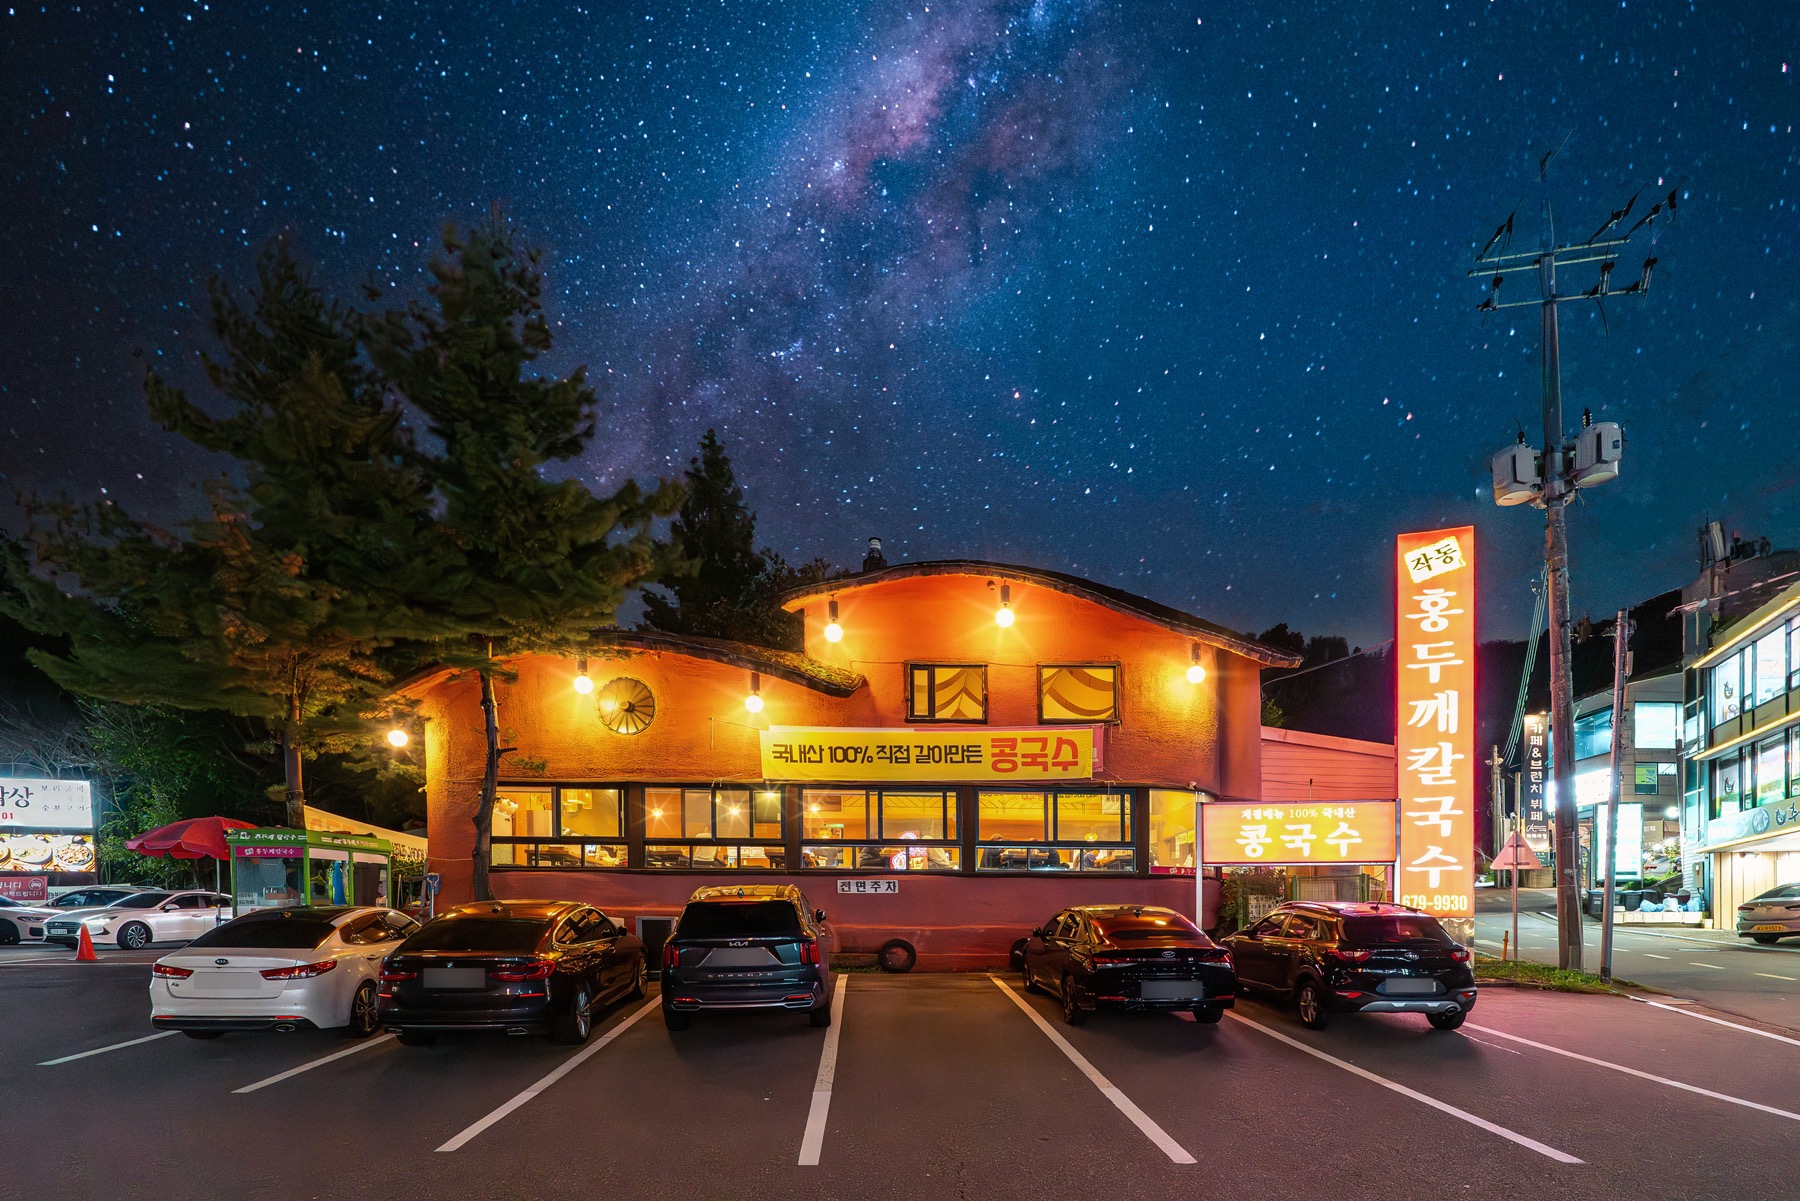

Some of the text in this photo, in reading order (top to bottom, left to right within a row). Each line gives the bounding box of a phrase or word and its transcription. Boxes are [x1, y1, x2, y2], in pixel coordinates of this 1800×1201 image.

[1411, 543, 1457, 571] 작동
[772, 736, 1079, 773] 국내산 100% 직접 갈아만든 콩국수
[1529, 723, 1544, 795] 카페&브런치
[1289, 808, 1318, 819] 100%
[1322, 807, 1356, 819] 국내산
[1530, 798, 1543, 822] 뷔페
[1235, 822, 1363, 858] 콩국수
[0, 881, 22, 889] 니다
[840, 880, 897, 893] 전면주차
[1402, 894, 1468, 911] 679-9930
